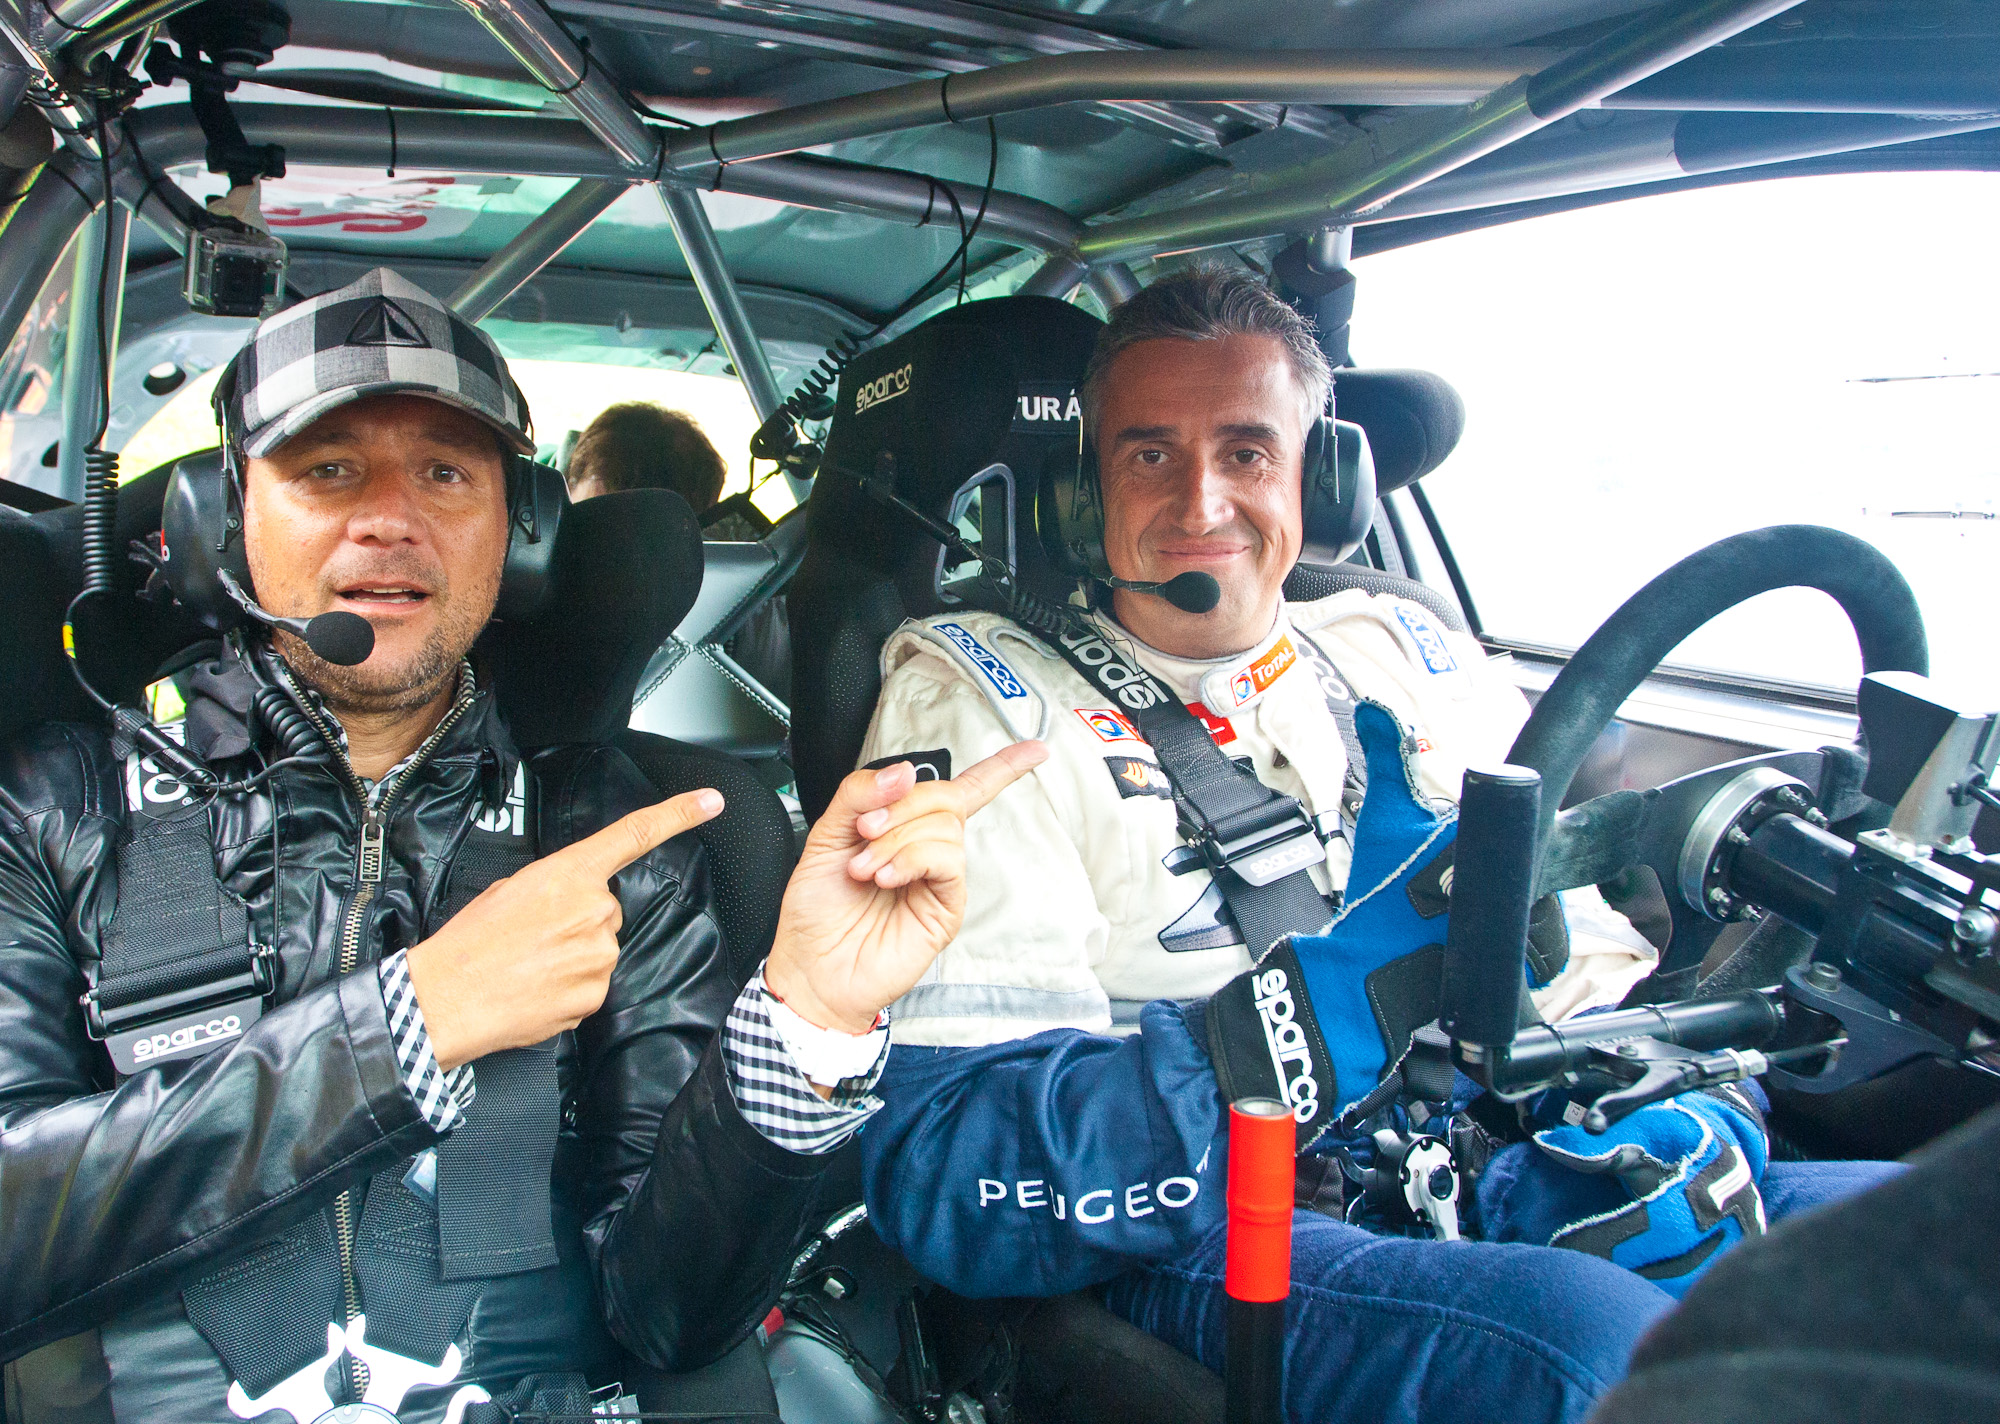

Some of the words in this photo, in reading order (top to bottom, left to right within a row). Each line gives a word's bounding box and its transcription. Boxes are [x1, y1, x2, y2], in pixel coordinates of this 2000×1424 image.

[856, 363, 913, 416] sparco
[936, 625, 1022, 696] sparco
[1060, 633, 1169, 709] spar
[1253, 647, 1294, 683] TOTAL
[1250, 844, 1315, 879] sparco
[133, 1015, 242, 1064] sparco
[1252, 968, 1319, 1124] sparco
